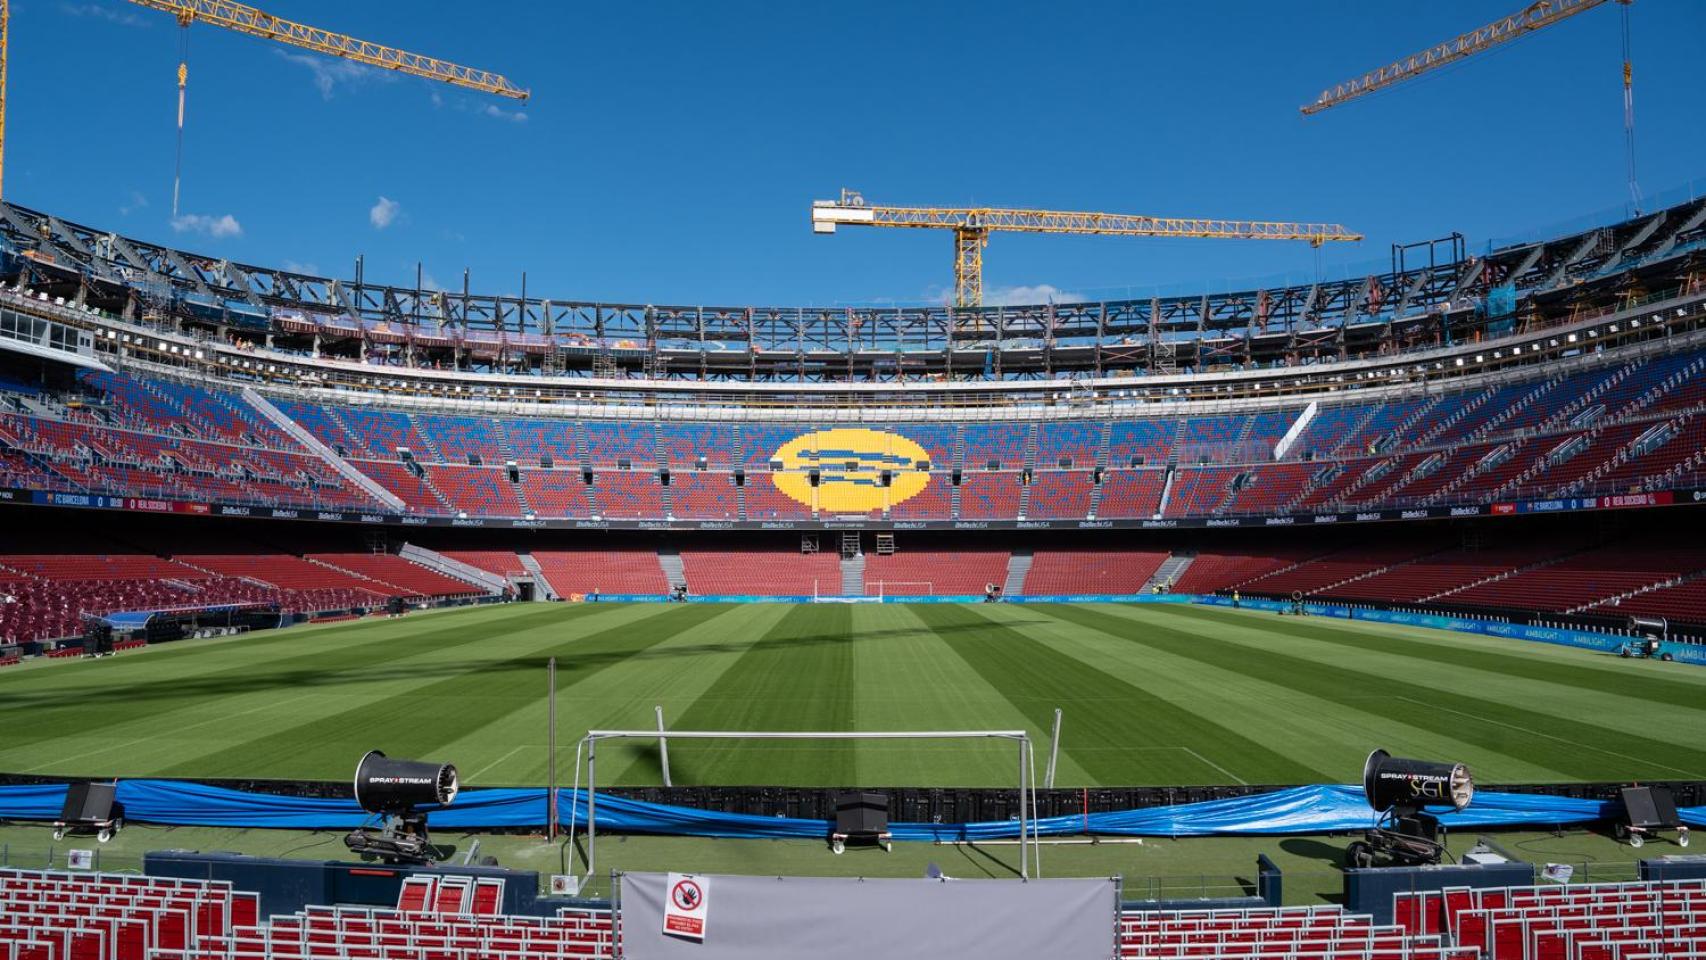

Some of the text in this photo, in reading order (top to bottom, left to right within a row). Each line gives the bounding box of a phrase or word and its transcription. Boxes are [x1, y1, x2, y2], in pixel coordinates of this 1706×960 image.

[63, 495, 90, 505] BARCELONA
[1624, 494, 1648, 505] SOCIEDAD
[1540, 500, 1563, 510] BARCELONA
[1525, 630, 1558, 640] AMBILIGHT
[1574, 636, 1606, 646] AMBILIGHT
